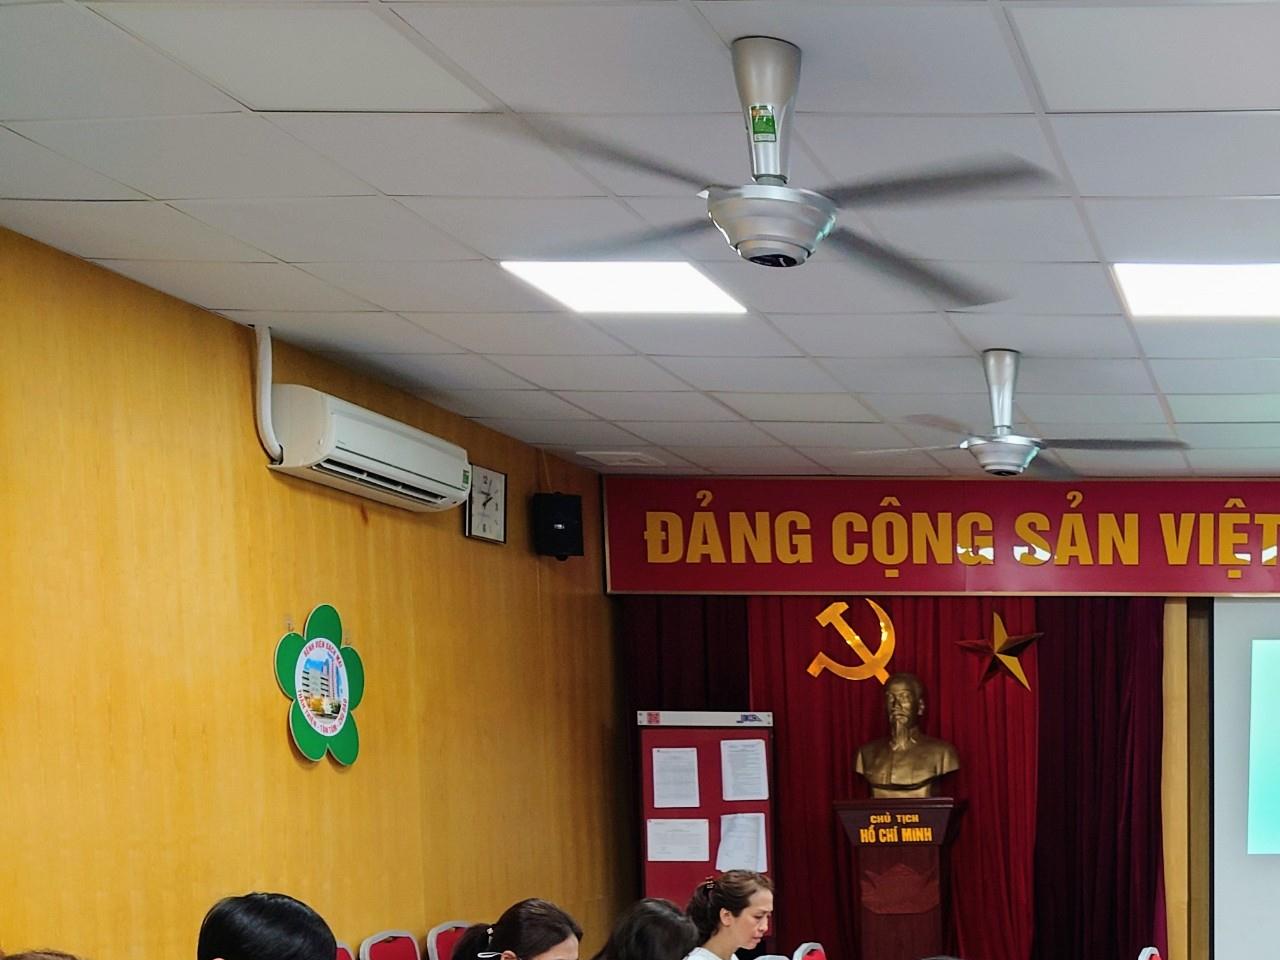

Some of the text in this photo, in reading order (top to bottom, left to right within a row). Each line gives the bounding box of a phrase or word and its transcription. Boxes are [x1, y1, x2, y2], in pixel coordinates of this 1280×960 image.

[644, 490, 813, 564] ĐẢNG
[831, 496, 995, 578] CỘNG
[1013, 491, 1140, 566] SẢN
[870, 812, 920, 825] CHỦ TỊCH
[860, 824, 933, 843] HỒ CHÍ MINH
